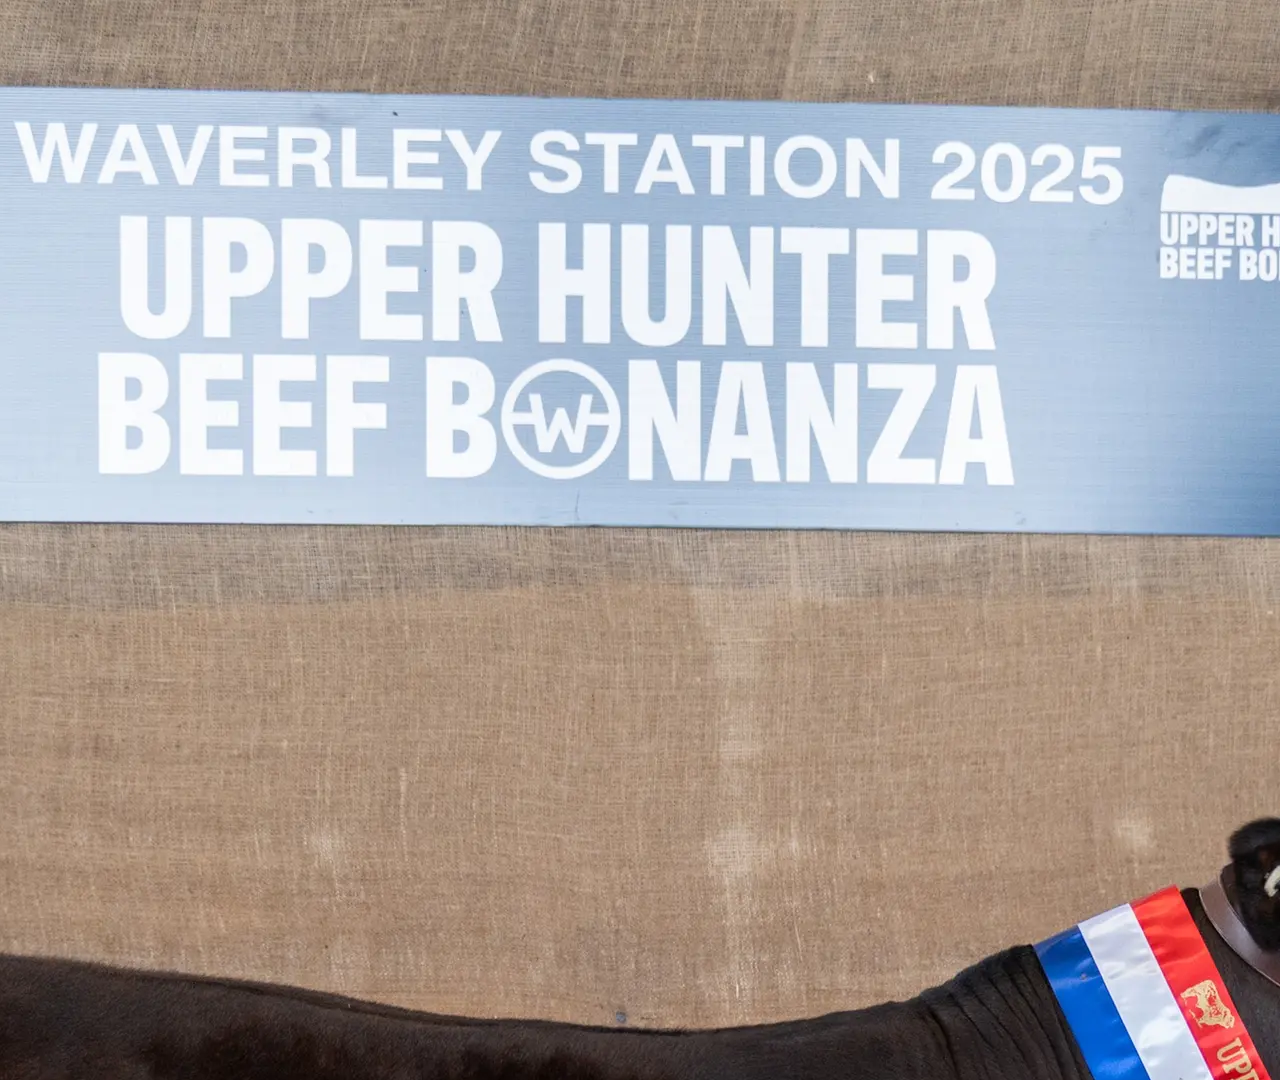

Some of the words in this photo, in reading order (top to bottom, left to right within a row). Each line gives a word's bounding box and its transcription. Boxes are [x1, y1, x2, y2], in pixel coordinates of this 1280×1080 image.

[15, 122, 501, 190] WAVERLEY
[529, 130, 900, 199] STATION
[930, 141, 1124, 205] 2025
[1159, 247, 1231, 280] BEEF
[1160, 212, 1254, 247] UPPER
[119, 215, 503, 342] UPPER
[538, 222, 997, 351] HUNTER
[97, 351, 390, 477] BEEF
